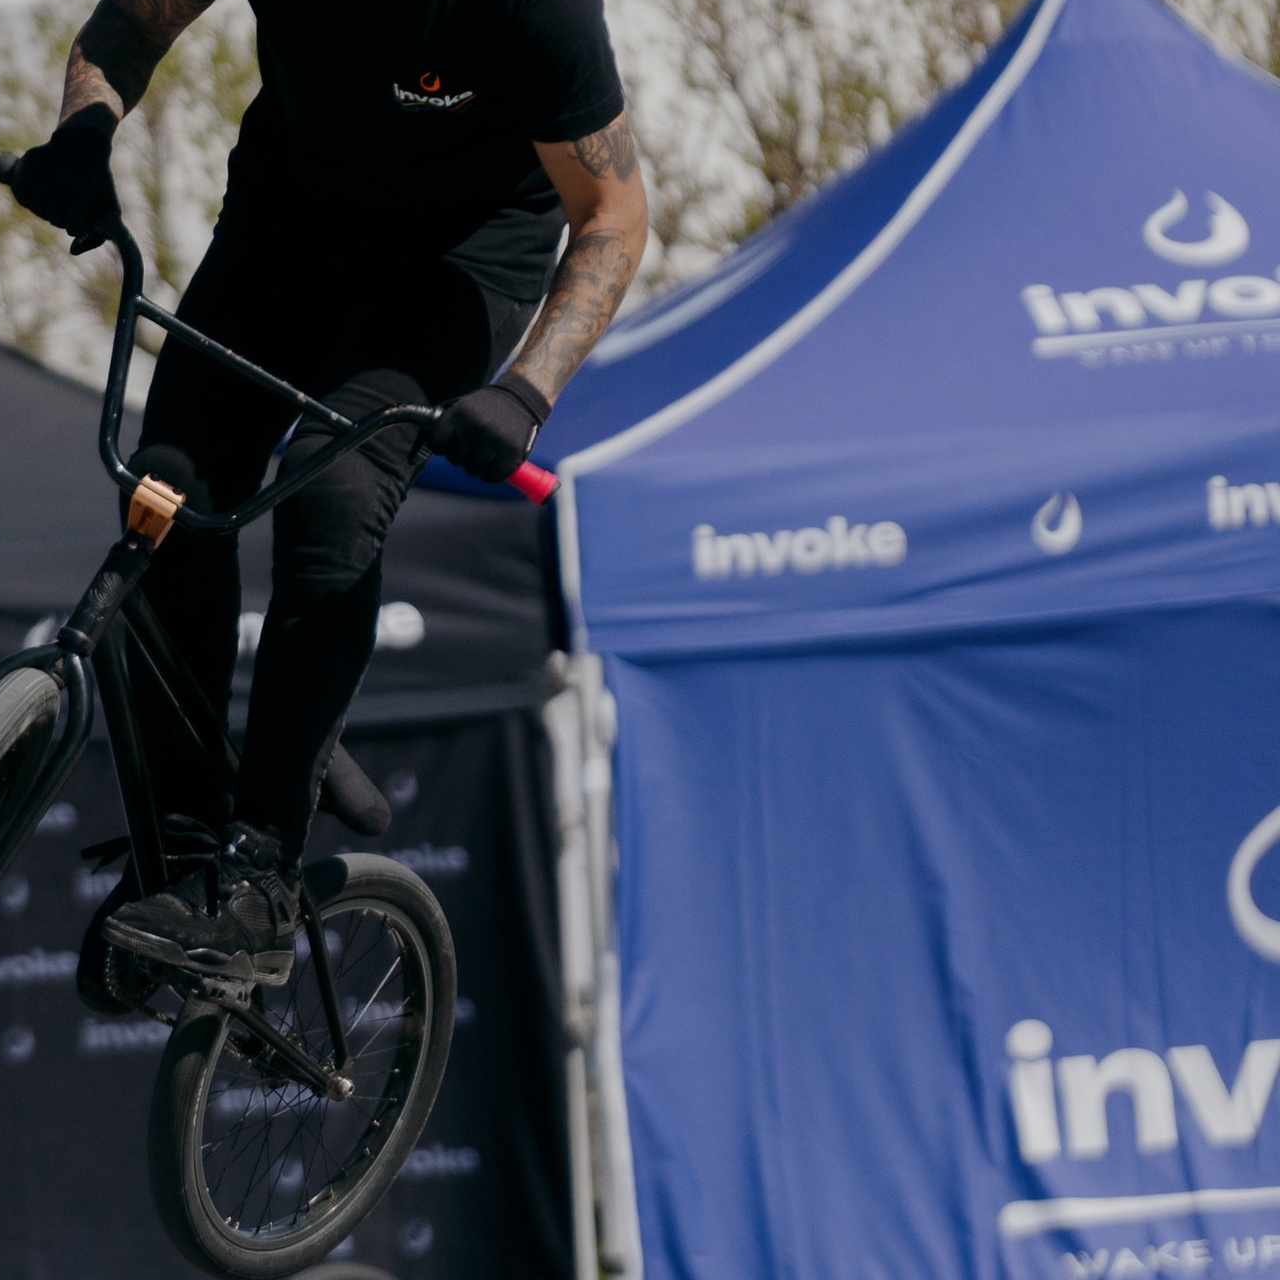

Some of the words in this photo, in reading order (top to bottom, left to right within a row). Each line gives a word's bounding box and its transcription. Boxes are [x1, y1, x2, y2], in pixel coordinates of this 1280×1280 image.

[393, 82, 473, 107] invoke
[1021, 265, 1280, 337] invo
[692, 515, 908, 581] invoke
